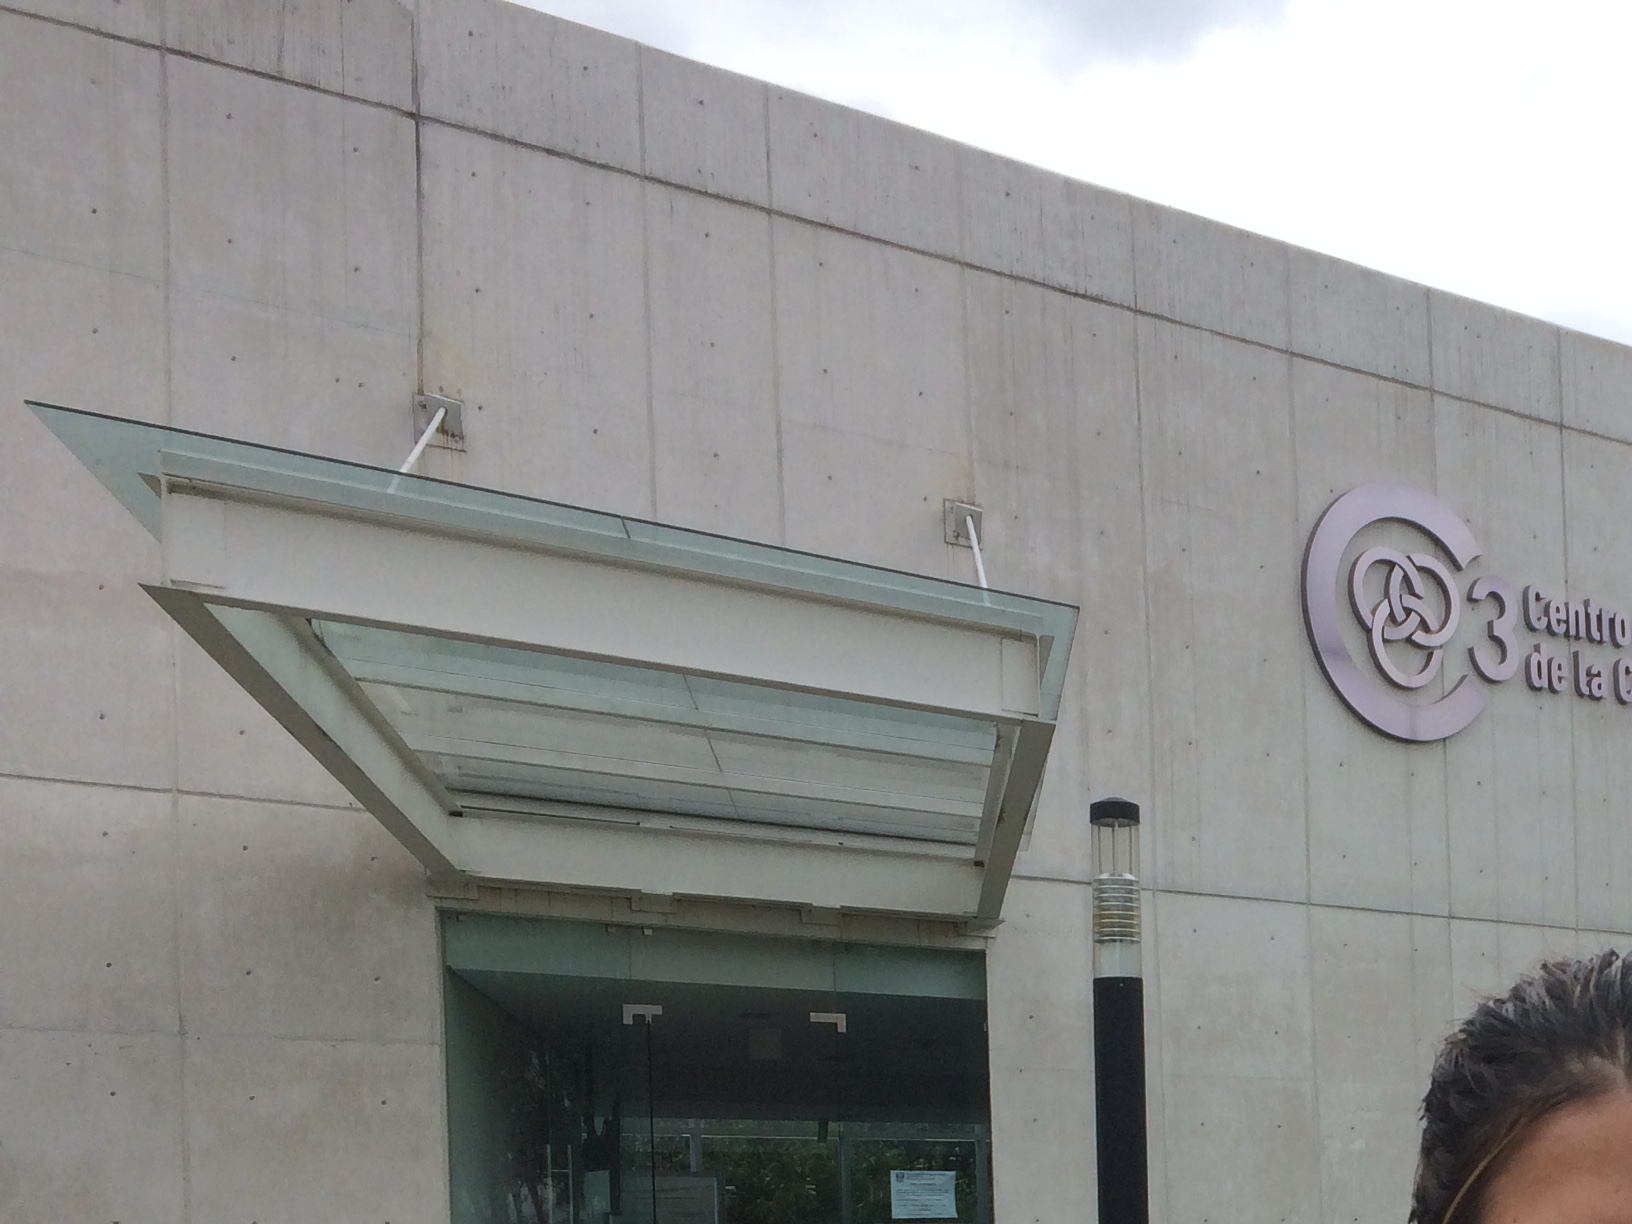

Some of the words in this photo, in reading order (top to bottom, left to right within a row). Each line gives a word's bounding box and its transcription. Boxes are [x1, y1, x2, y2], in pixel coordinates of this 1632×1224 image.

[1523, 585, 1632, 648] Centro
[1525, 643, 1569, 694] de
[1572, 650, 1608, 699] la
